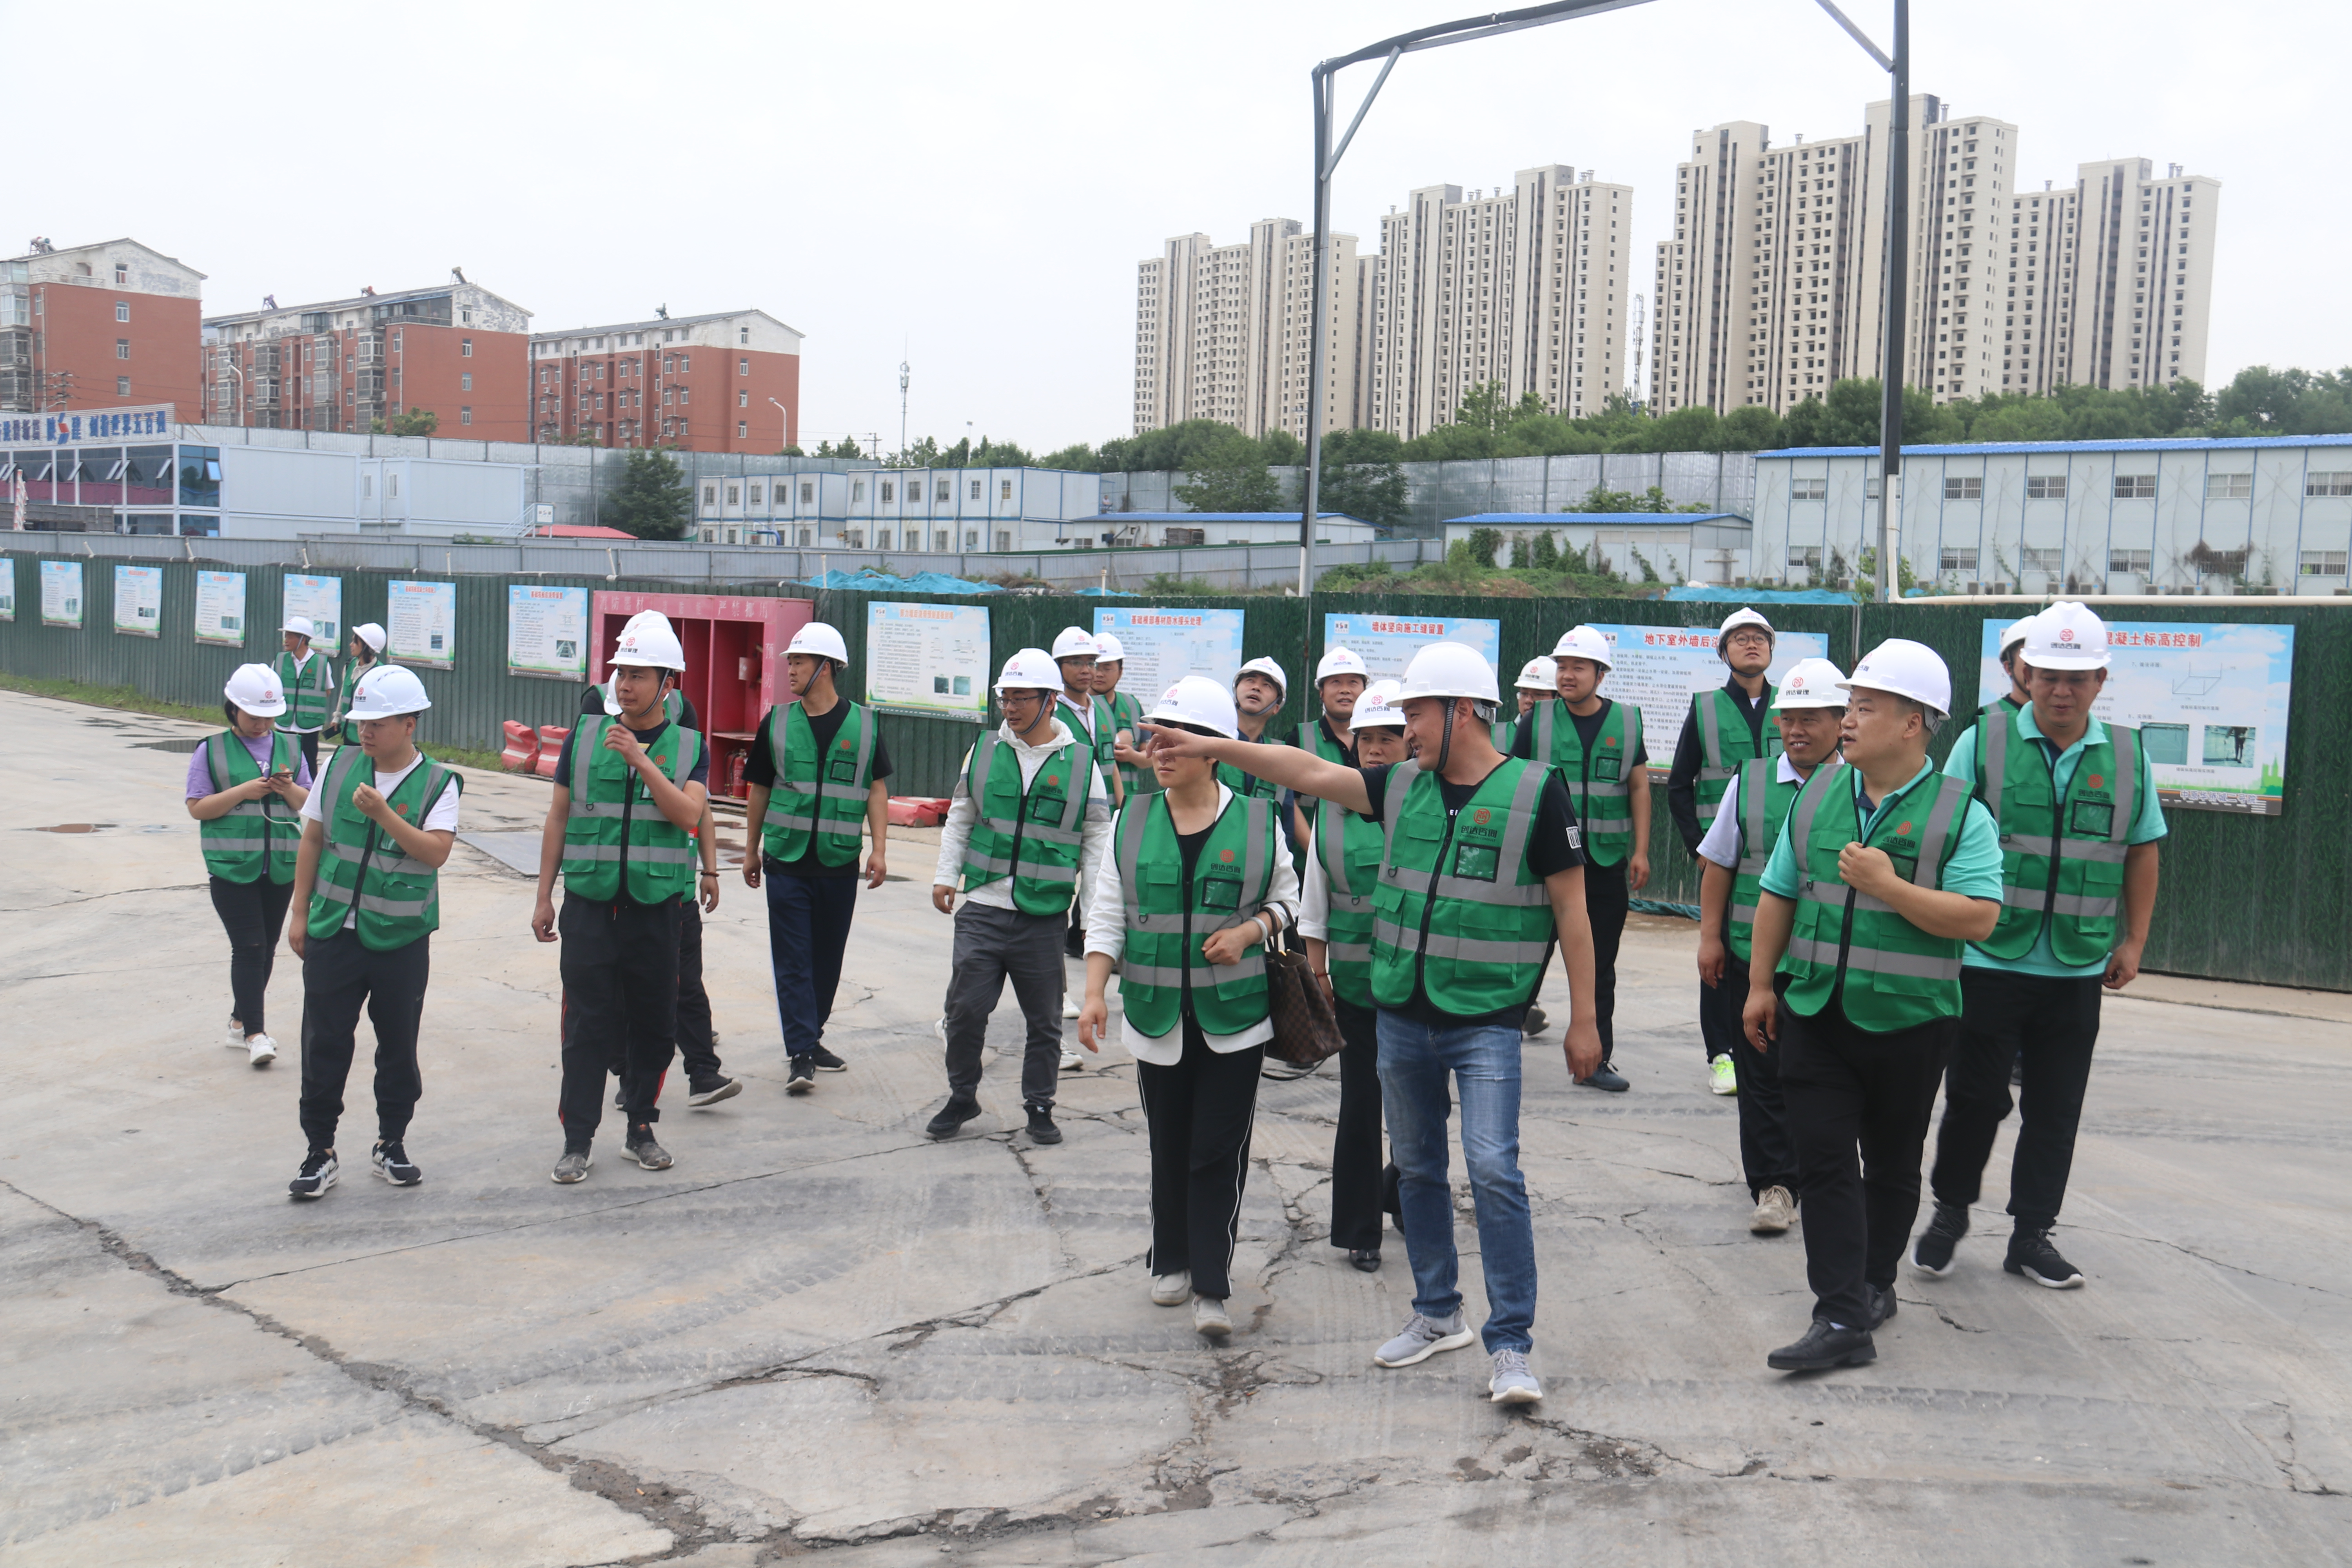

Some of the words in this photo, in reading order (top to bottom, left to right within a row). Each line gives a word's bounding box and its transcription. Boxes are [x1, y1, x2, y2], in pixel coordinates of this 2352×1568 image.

[718, 601, 768, 618] 严禁挪用
[1372, 621, 1444, 635] 墙体竖向施工缝留置
[2181, 791, 2257, 804] 中原华侨城二号院
[1461, 825, 1497, 838] 创达咨询
[1211, 863, 1241, 873] 创达咨询
